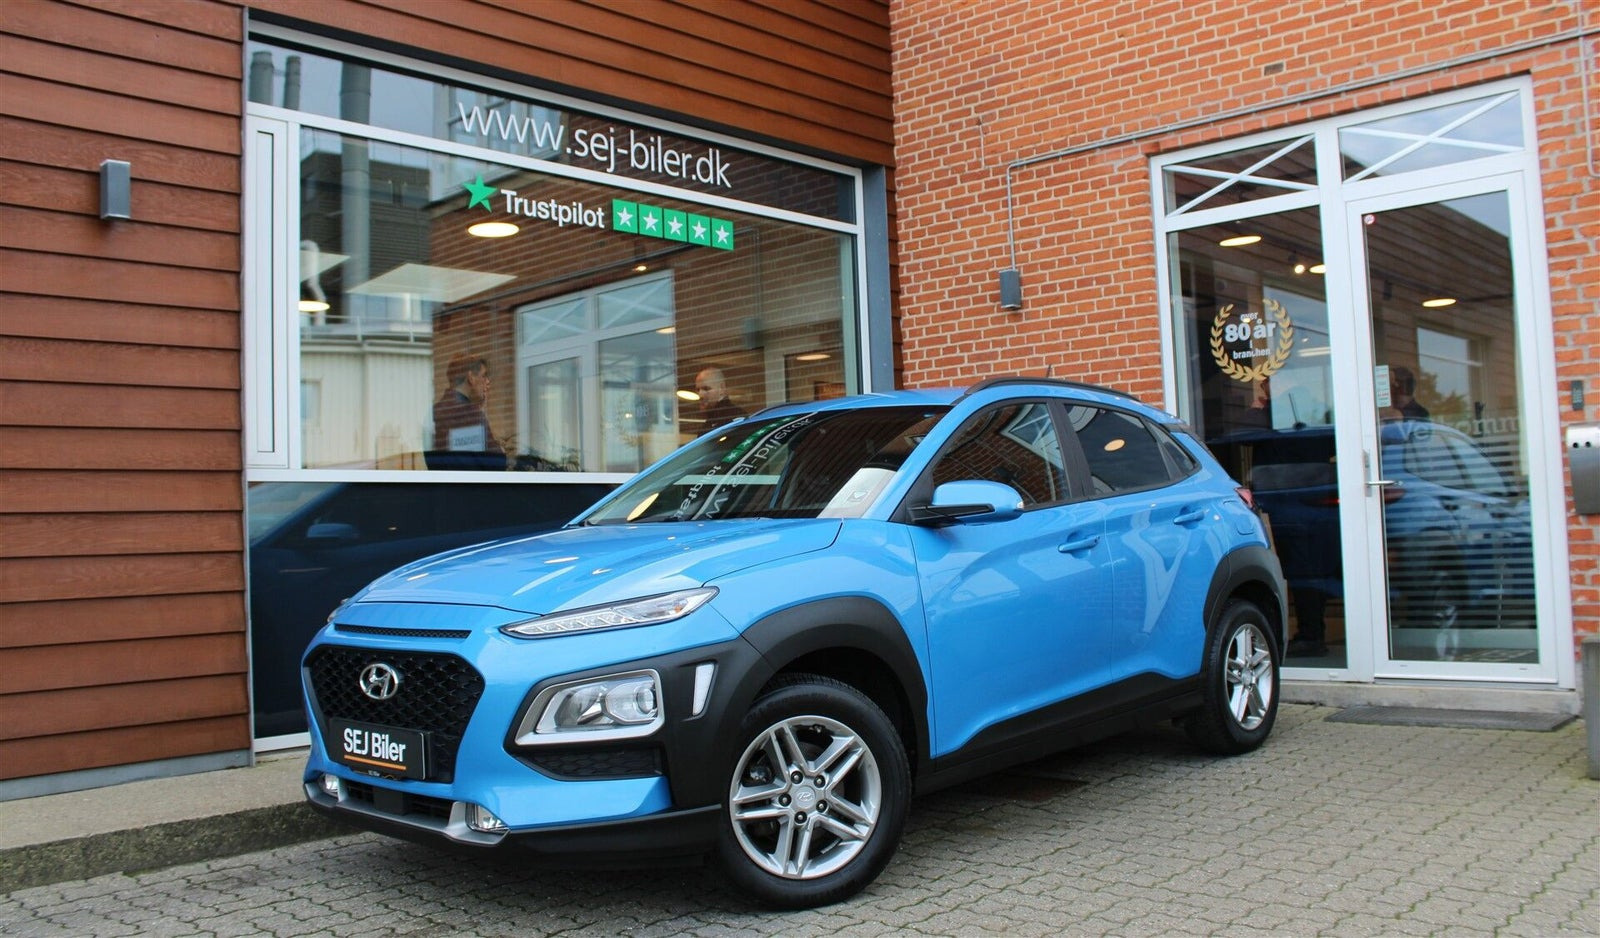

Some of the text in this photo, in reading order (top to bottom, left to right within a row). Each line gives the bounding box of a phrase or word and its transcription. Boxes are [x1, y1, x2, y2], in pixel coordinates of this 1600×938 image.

[458, 101, 732, 189] www.sej-biler.dk
[501, 189, 605, 229] Trustpilot
[1225, 318, 1276, 342] 80 år
[343, 727, 406, 762] SEJ Biler
